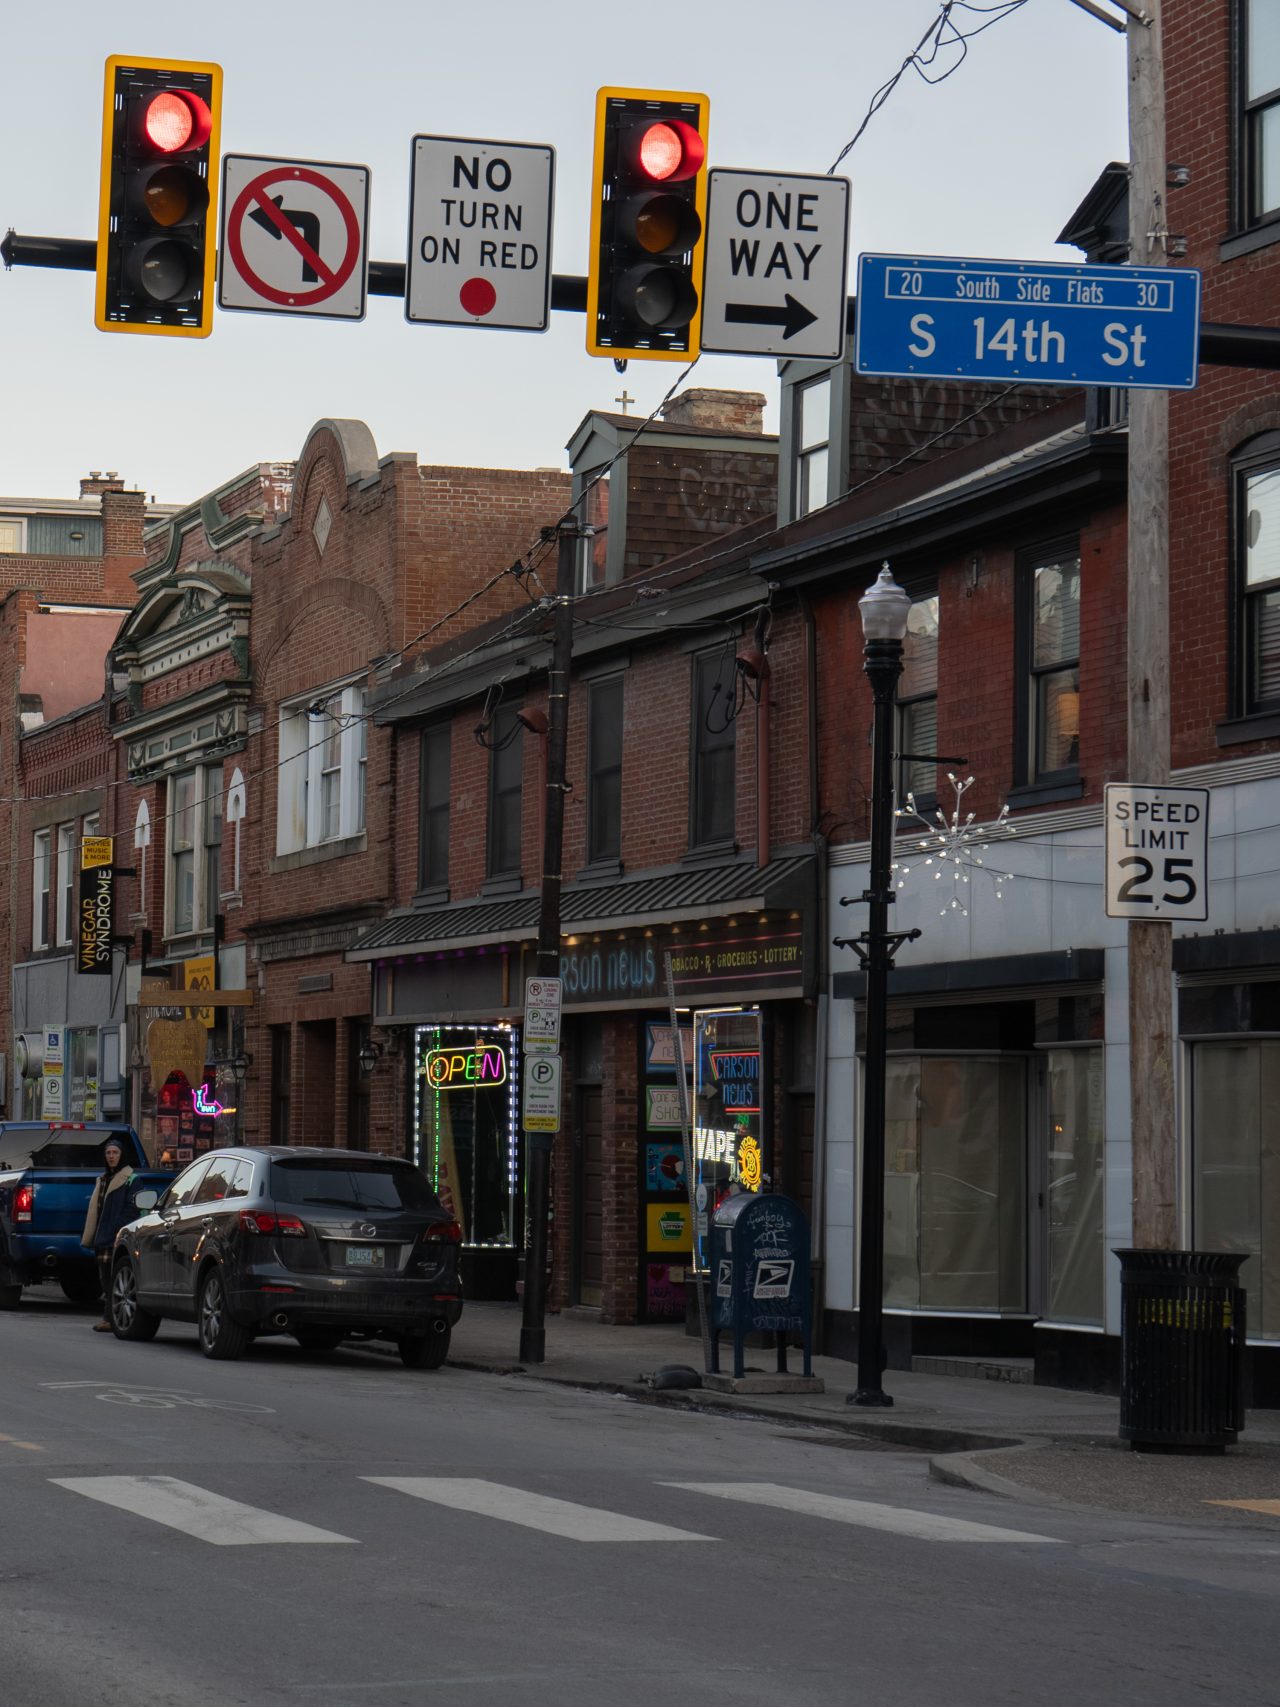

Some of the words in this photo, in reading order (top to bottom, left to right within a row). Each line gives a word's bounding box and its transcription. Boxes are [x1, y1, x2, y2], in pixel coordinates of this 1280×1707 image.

[453, 155, 512, 193] NO
[440, 198, 522, 232] TURN
[736, 188, 819, 232] ONE
[420, 235, 460, 265] ON
[479, 240, 539, 271] RED
[729, 237, 823, 281] WAY
[900, 271, 923, 295] 20
[955, 275, 1000, 300] South
[1016, 277, 1051, 302] Side
[1067, 280, 1104, 304] Flats
[1136, 283, 1158, 307] 30
[908, 313, 936, 358] S
[973, 316, 1066, 364] 14th
[1102, 322, 1147, 367] St
[1115, 801, 1200, 823] SPEED
[1125, 828, 1190, 850] LIMIT
[1117, 855, 1197, 905] 25
[96, 868, 112, 961] SYNDROME
[81, 898, 96, 970] VINEGAR
[560, 952, 603, 994] RSON
[671, 955, 700, 973] OBACCO
[717, 949, 758, 968] GROCERIES
[764, 946, 798, 964] LOTTERY
[429, 1052, 501, 1082] OPEN
[716, 1055, 760, 1080] CARSON
[655, 1105, 680, 1120] SHO
[695, 1127, 736, 1164] VAPE
